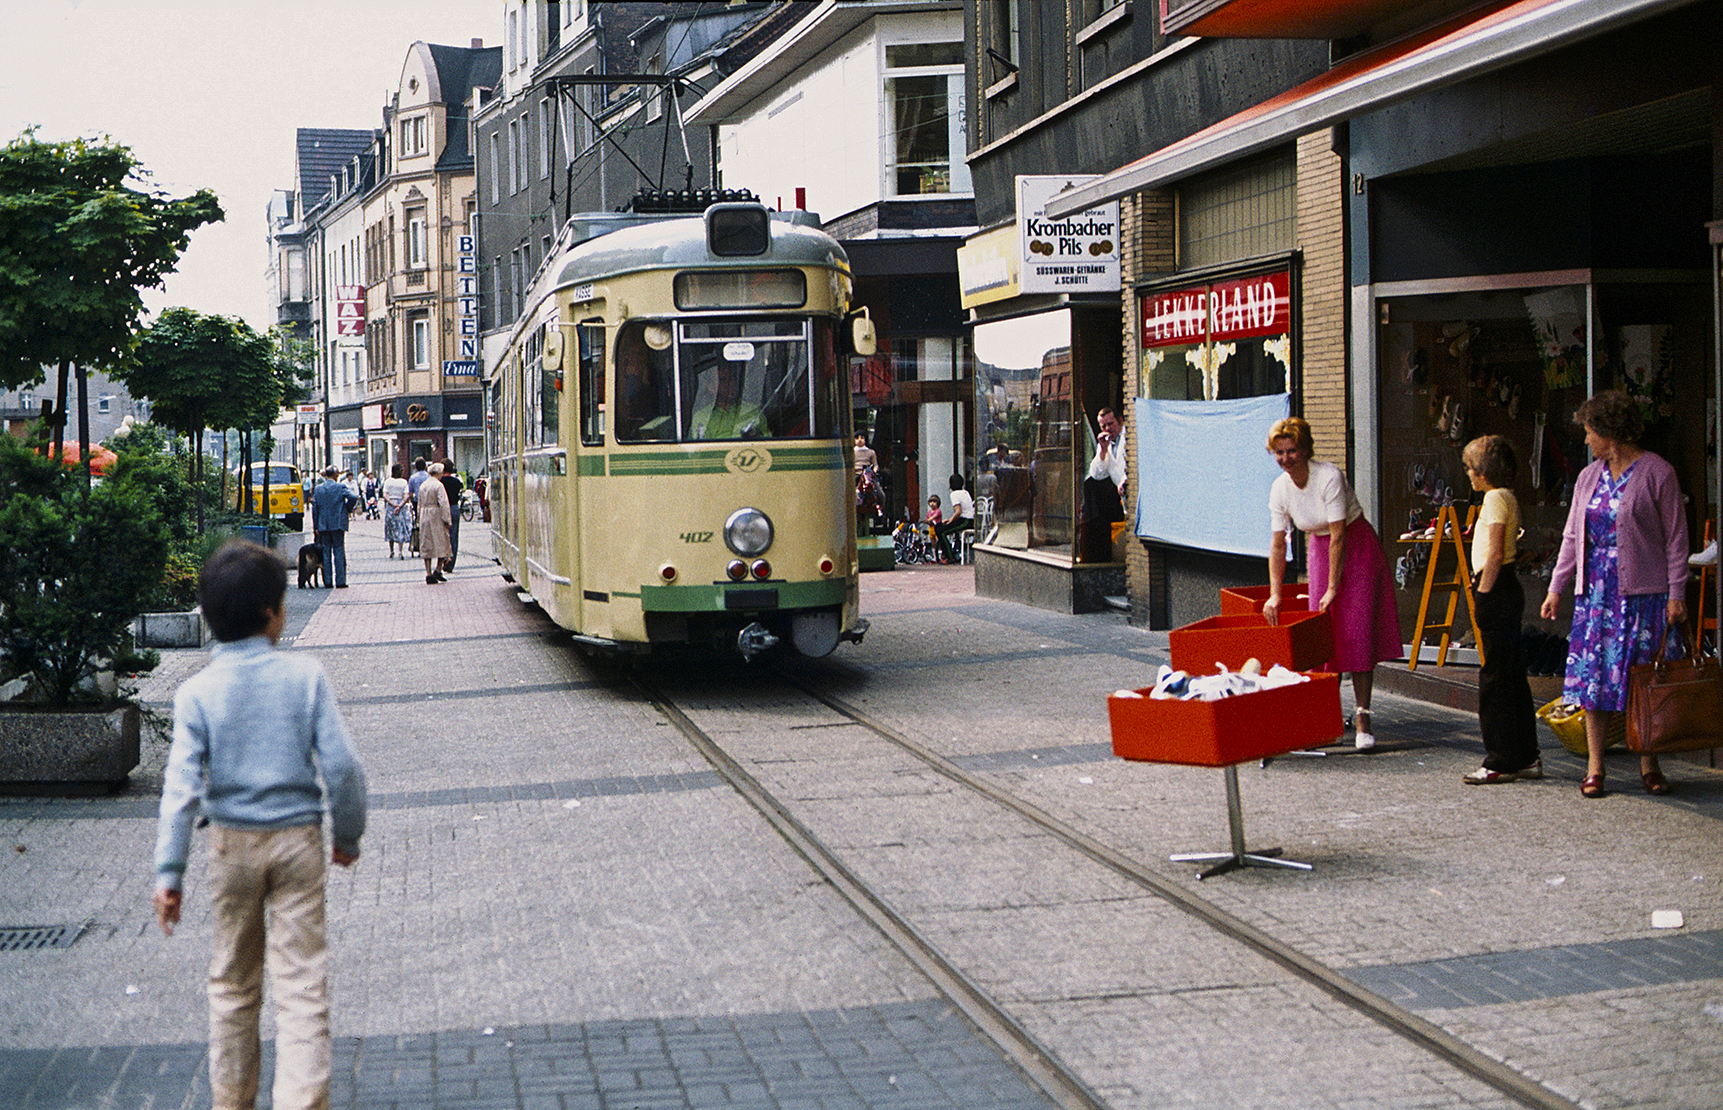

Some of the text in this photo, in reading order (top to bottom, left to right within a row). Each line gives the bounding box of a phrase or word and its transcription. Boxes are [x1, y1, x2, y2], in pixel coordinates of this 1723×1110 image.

[1352, 172, 1364, 196] 12
[1027, 218, 1114, 236] Krombacher
[1059, 237, 1083, 255] Pils
[1055, 275, 1089, 285] J. SCHÜTTE
[460, 236, 475, 356] BETTEN
[337, 286, 359, 333] WAZ
[1154, 282, 1276, 341] LEKKERLAND
[445, 362, 476, 376] Erna
[680, 531, 714, 543] 402
